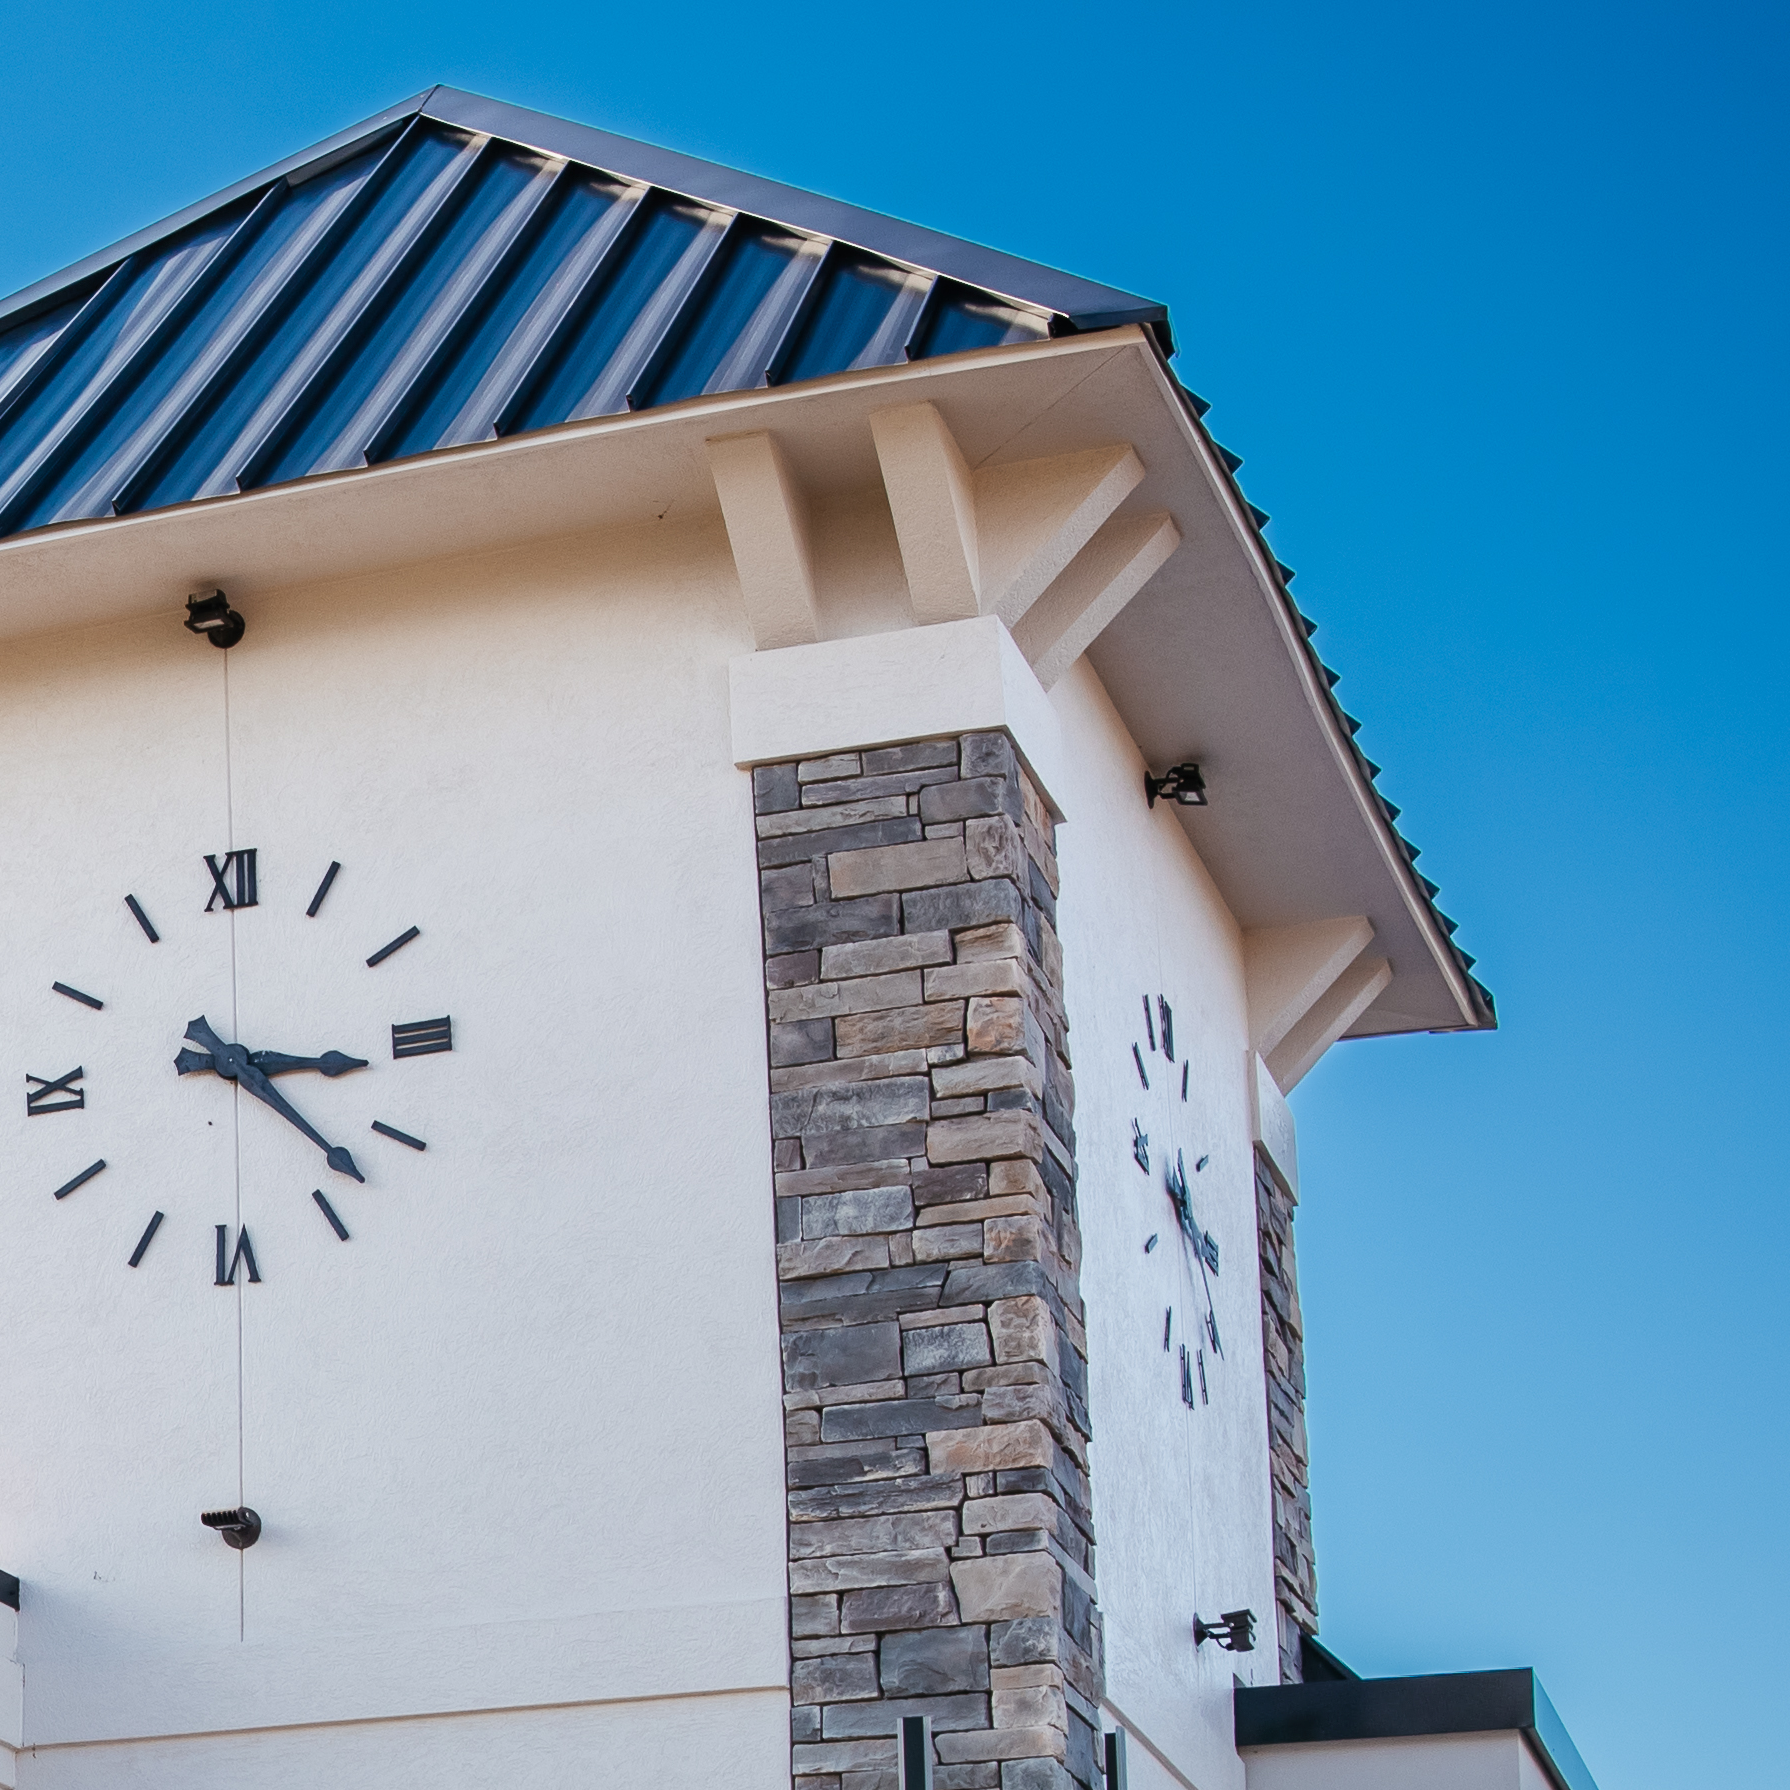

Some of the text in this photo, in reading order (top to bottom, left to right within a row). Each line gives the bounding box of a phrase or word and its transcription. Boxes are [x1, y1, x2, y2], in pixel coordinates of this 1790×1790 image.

[204, 848, 258, 912] XII
[391, 1015, 453, 1060] III
[214, 1224, 262, 1286] VI
